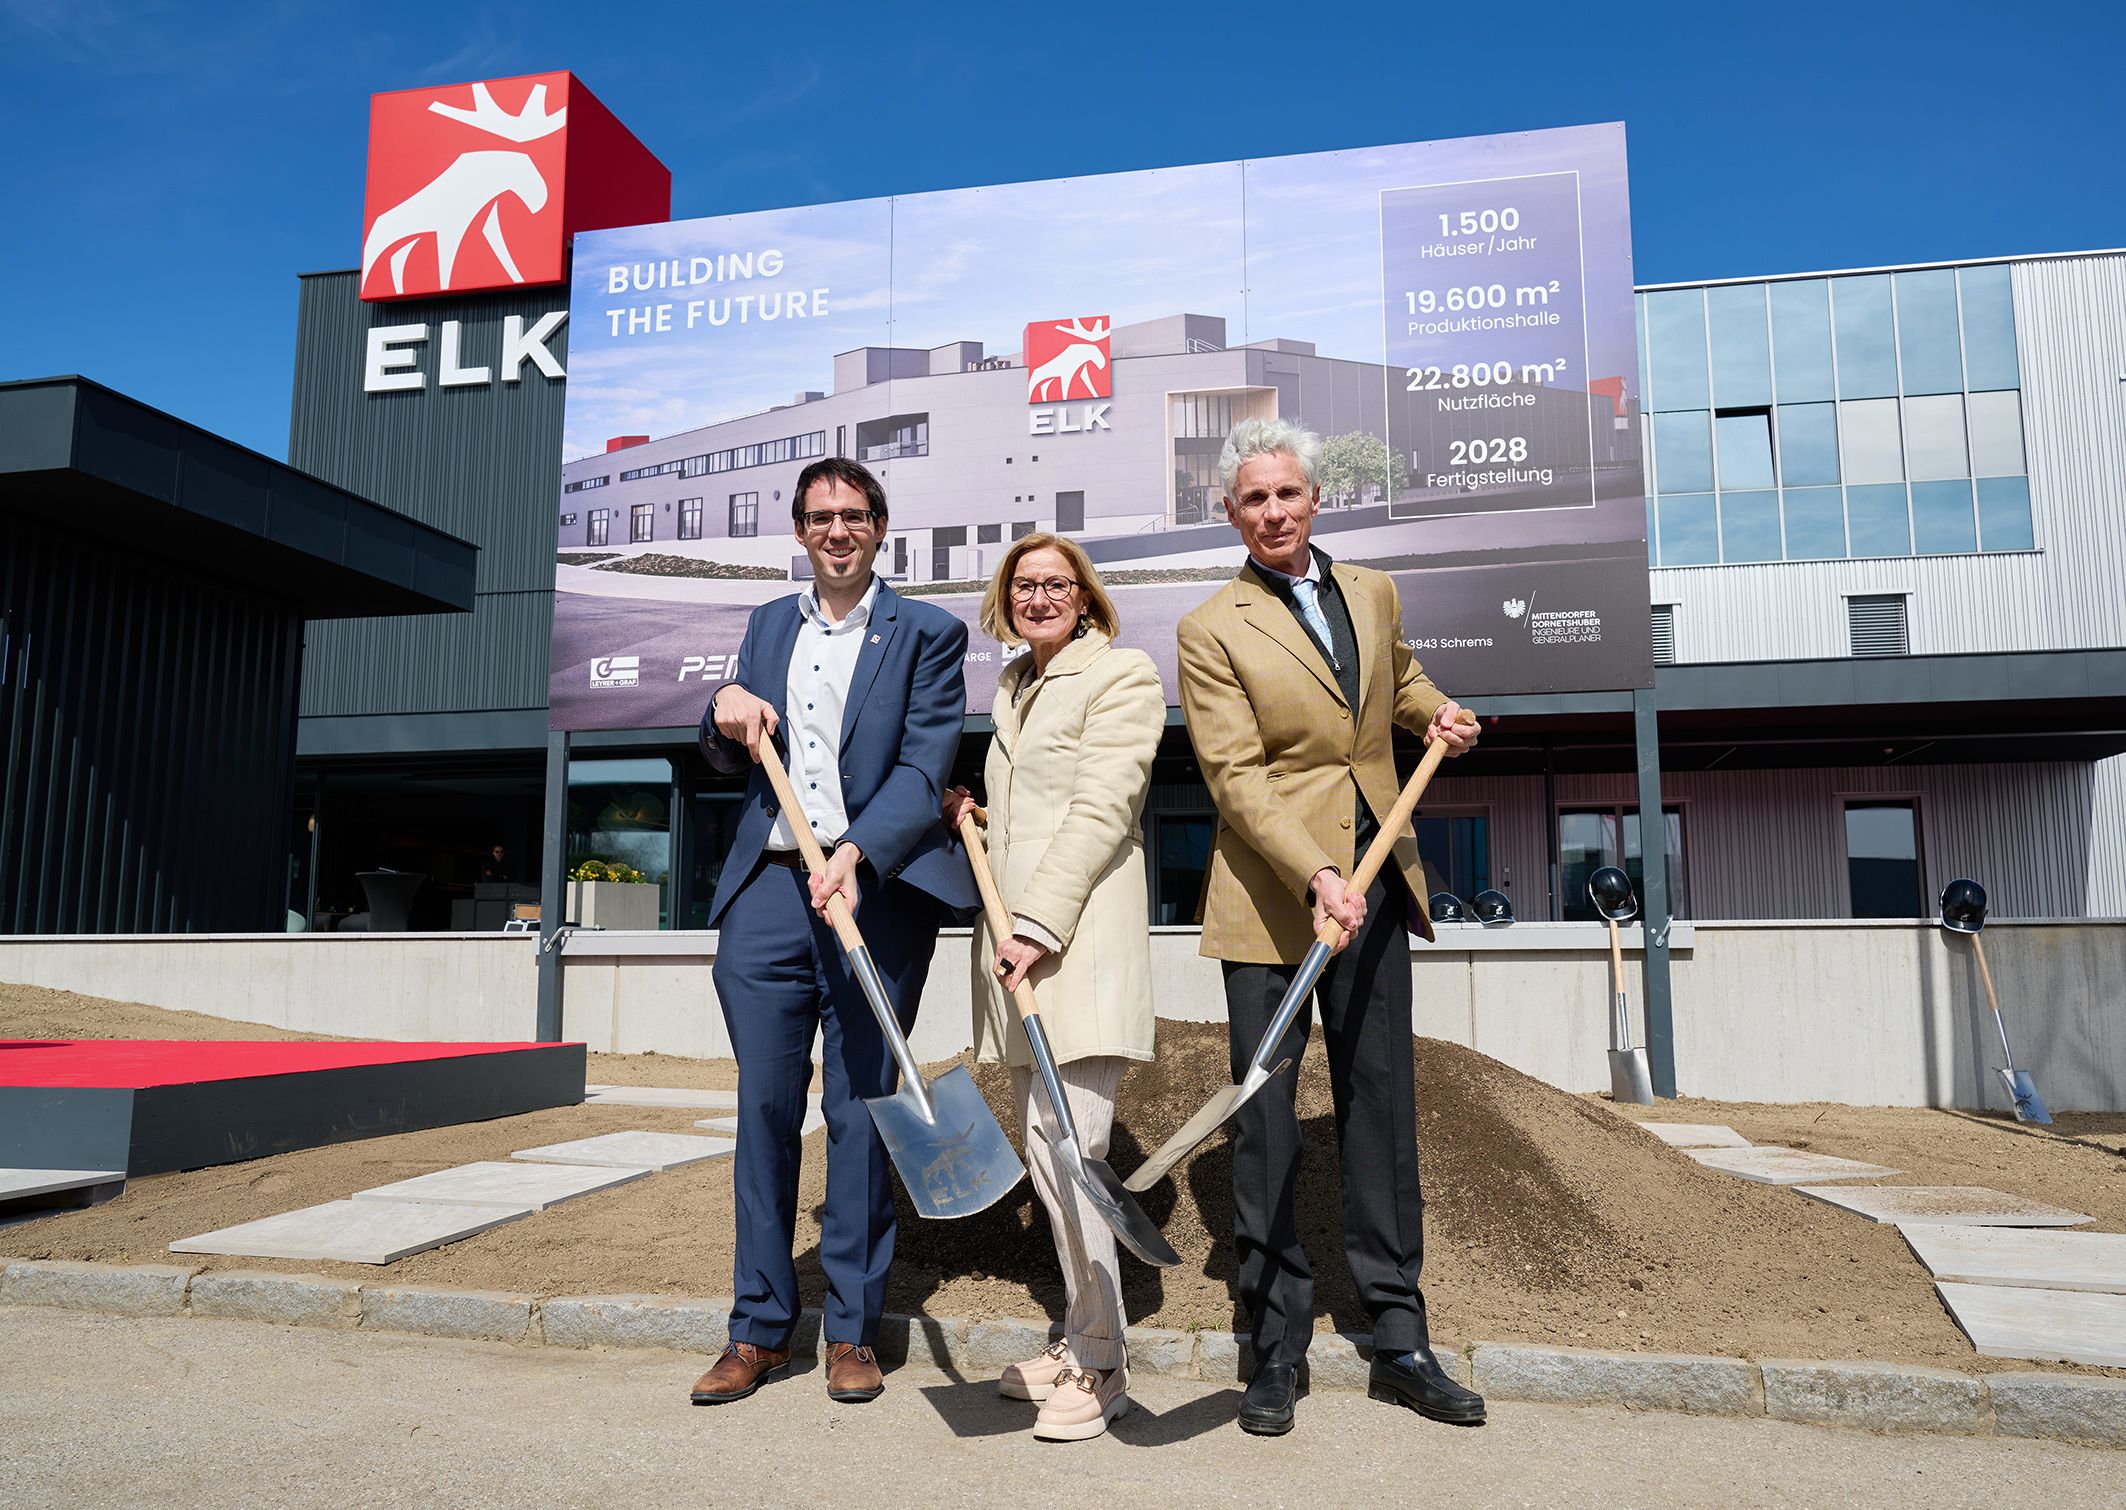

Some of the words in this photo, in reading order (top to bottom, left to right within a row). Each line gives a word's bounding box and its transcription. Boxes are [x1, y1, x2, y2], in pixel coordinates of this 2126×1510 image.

[1438, 207, 1520, 237] 1.500
[608, 249, 785, 294] BUILDING
[606, 304, 673, 337] THE
[687, 288, 830, 329] FUTURE
[1405, 284, 1507, 315] 19.600
[1408, 311, 1561, 336] Produktionshalle
[364, 311, 568, 393] ELK
[1405, 361, 1513, 392] 22.800
[1437, 392, 1537, 412] Nutzfläche
[1030, 403, 1111, 435] ELK
[1449, 437, 1529, 465] 2028
[1427, 468, 1553, 490] Fertigstellung
[1531, 610, 1596, 620] MITTENDORFER
[1532, 618, 1601, 629] DORNETSHUBER
[1440, 637, 1493, 649] Schrems
[1532, 627, 1580, 636] INGENIEURE
[1581, 626, 1601, 634] UND
[1532, 634, 1602, 645] GENERALPLANER
